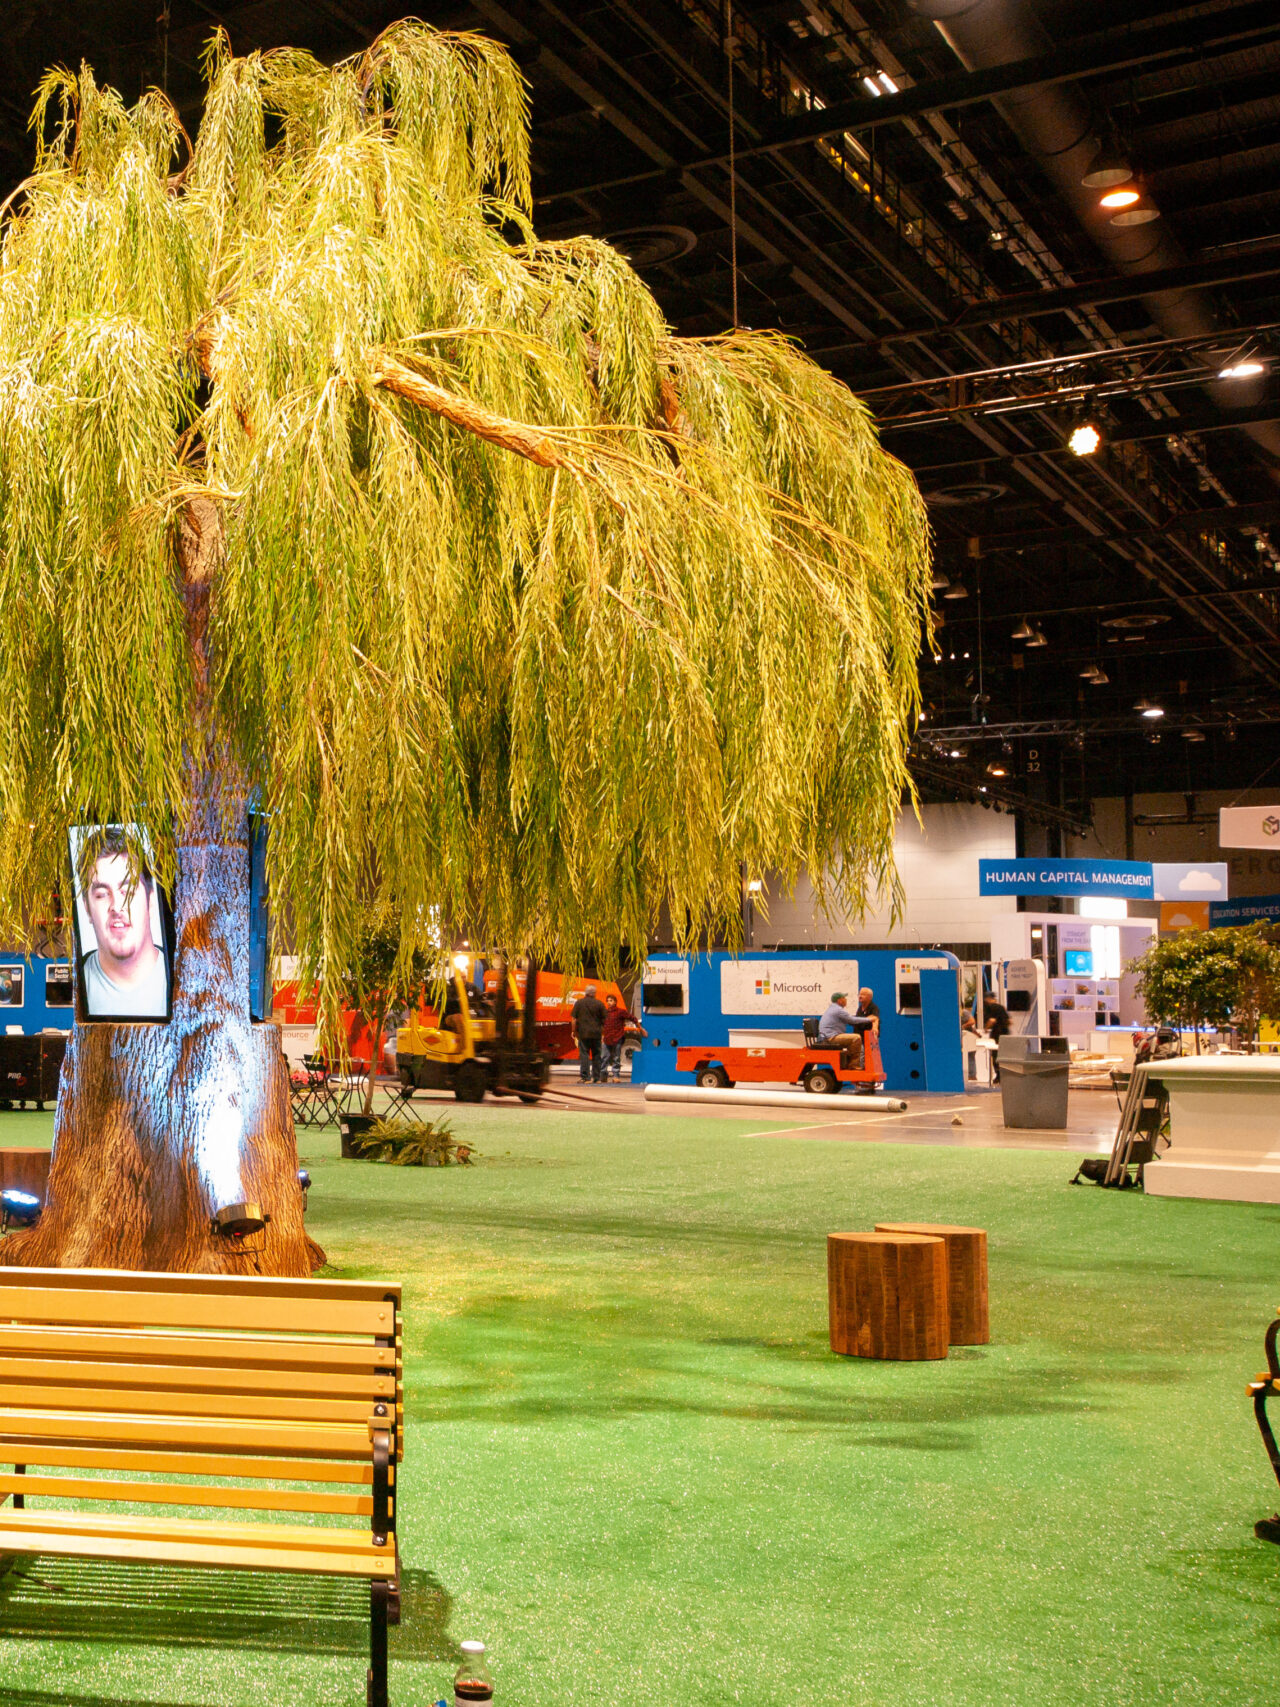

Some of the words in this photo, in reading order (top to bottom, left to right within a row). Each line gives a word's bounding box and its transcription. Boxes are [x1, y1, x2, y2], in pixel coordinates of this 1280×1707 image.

[1029, 749, 1039, 760] D
[1026, 762, 1041, 773] 32
[986, 871, 1036, 883] HUMAN
[1039, 871, 1089, 883] CAPITAL
[1091, 872, 1152, 887] MANAGEMENT
[773, 982, 822, 993] Microsoft
